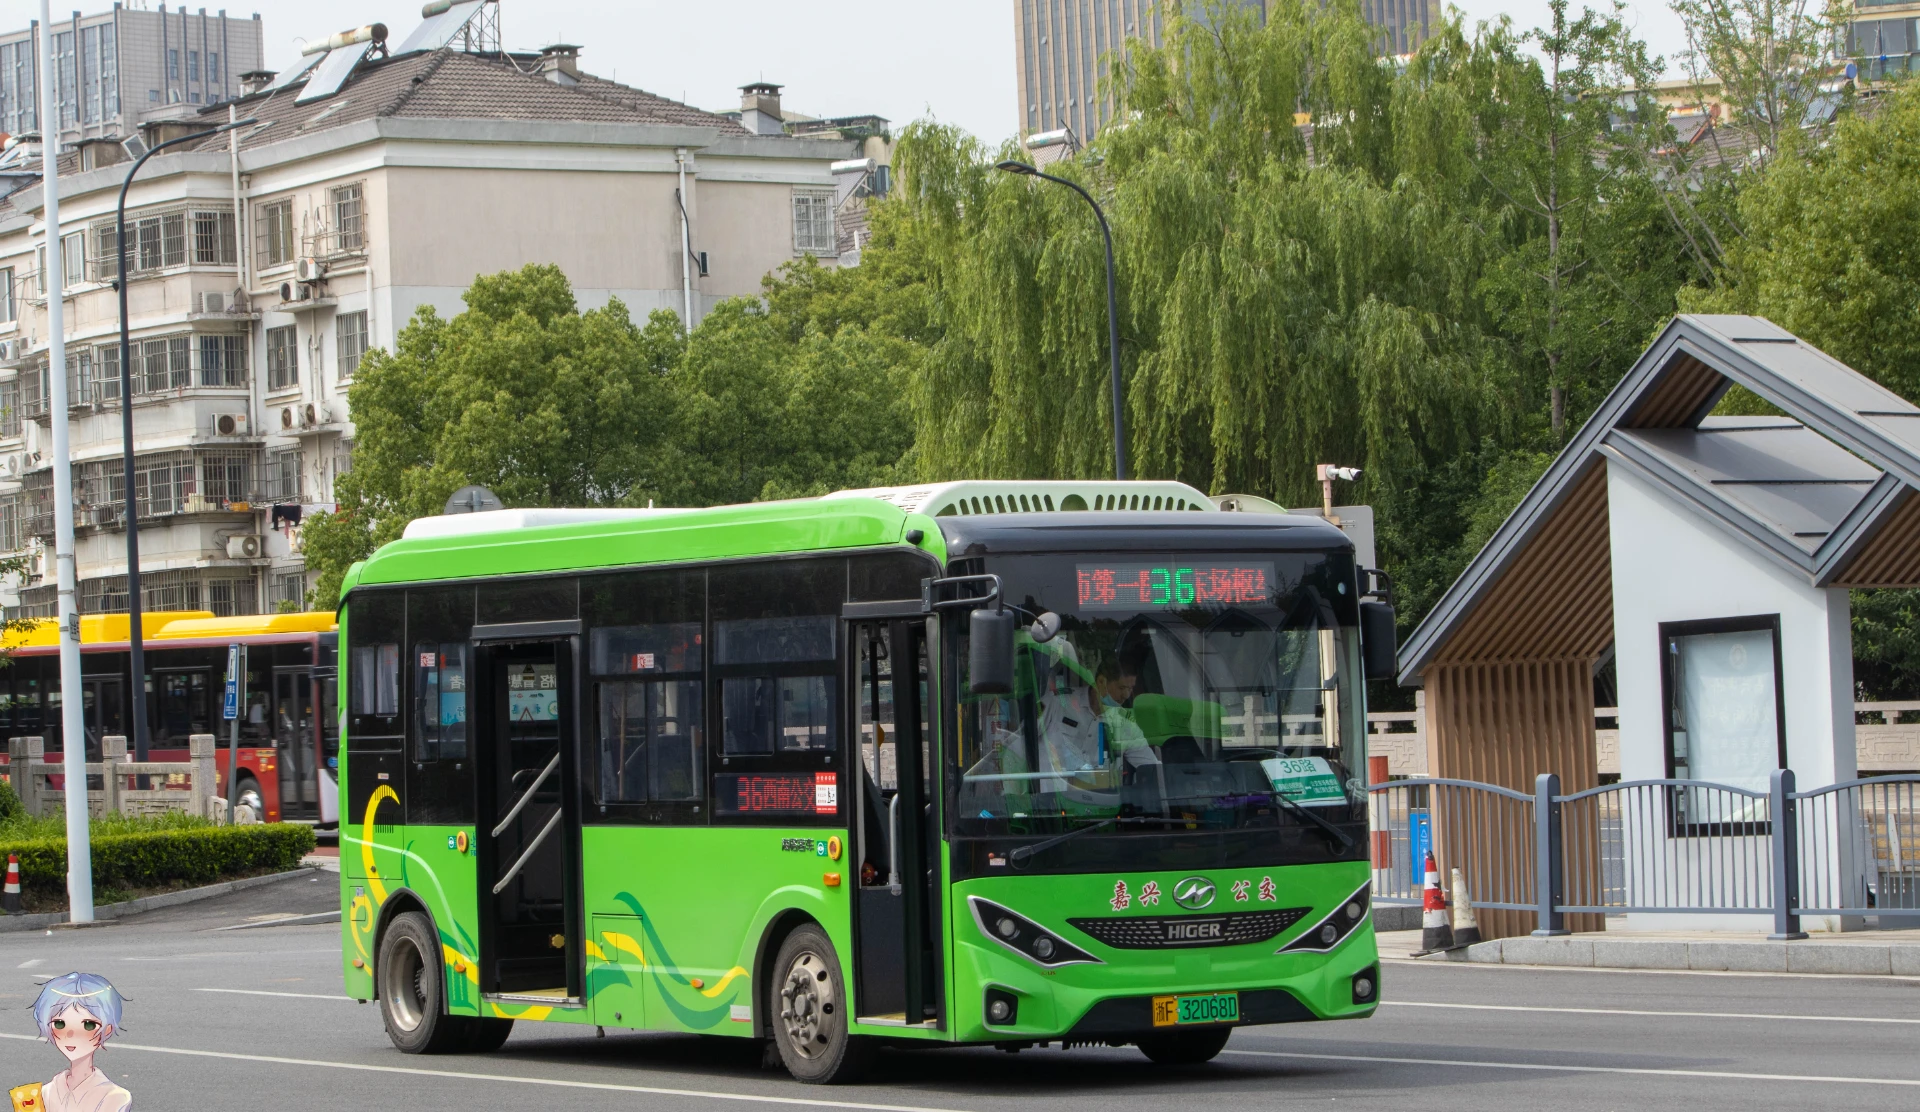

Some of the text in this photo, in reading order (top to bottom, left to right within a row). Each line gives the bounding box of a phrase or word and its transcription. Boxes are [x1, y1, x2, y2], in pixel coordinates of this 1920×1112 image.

[1151, 567, 1195, 605] 36
[1279, 758, 1317, 774] 36路
[1110, 876, 1277, 911] 嘉兴 公交
[1167, 922, 1221, 940] HIGER
